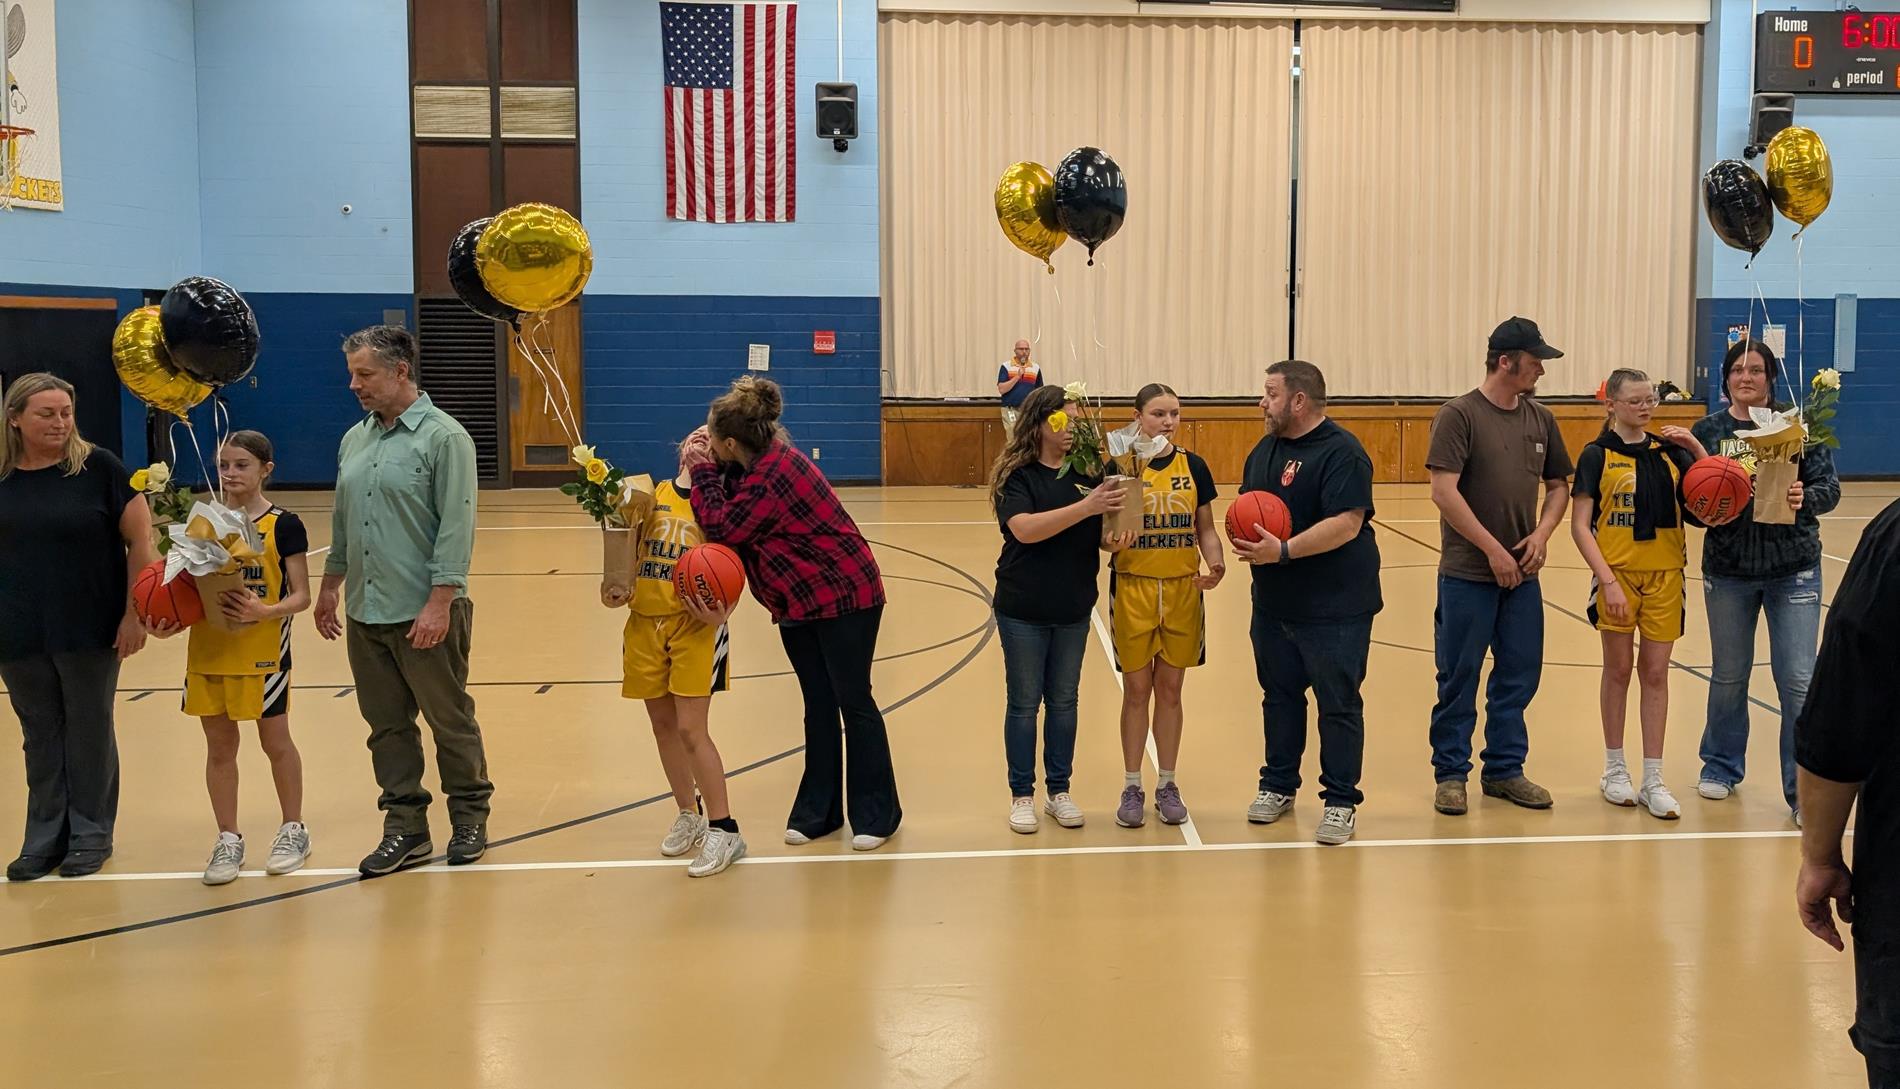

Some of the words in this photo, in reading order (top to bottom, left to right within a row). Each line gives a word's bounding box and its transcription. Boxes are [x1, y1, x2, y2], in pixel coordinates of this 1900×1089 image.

[1774, 16, 1808, 32] Home
[1793, 35, 1814, 69] 0
[1846, 70, 1883, 87] period
[10, 175, 61, 203] CKETS
[1170, 476, 1192, 490] 22
[1143, 514, 1192, 529] ELLOW
